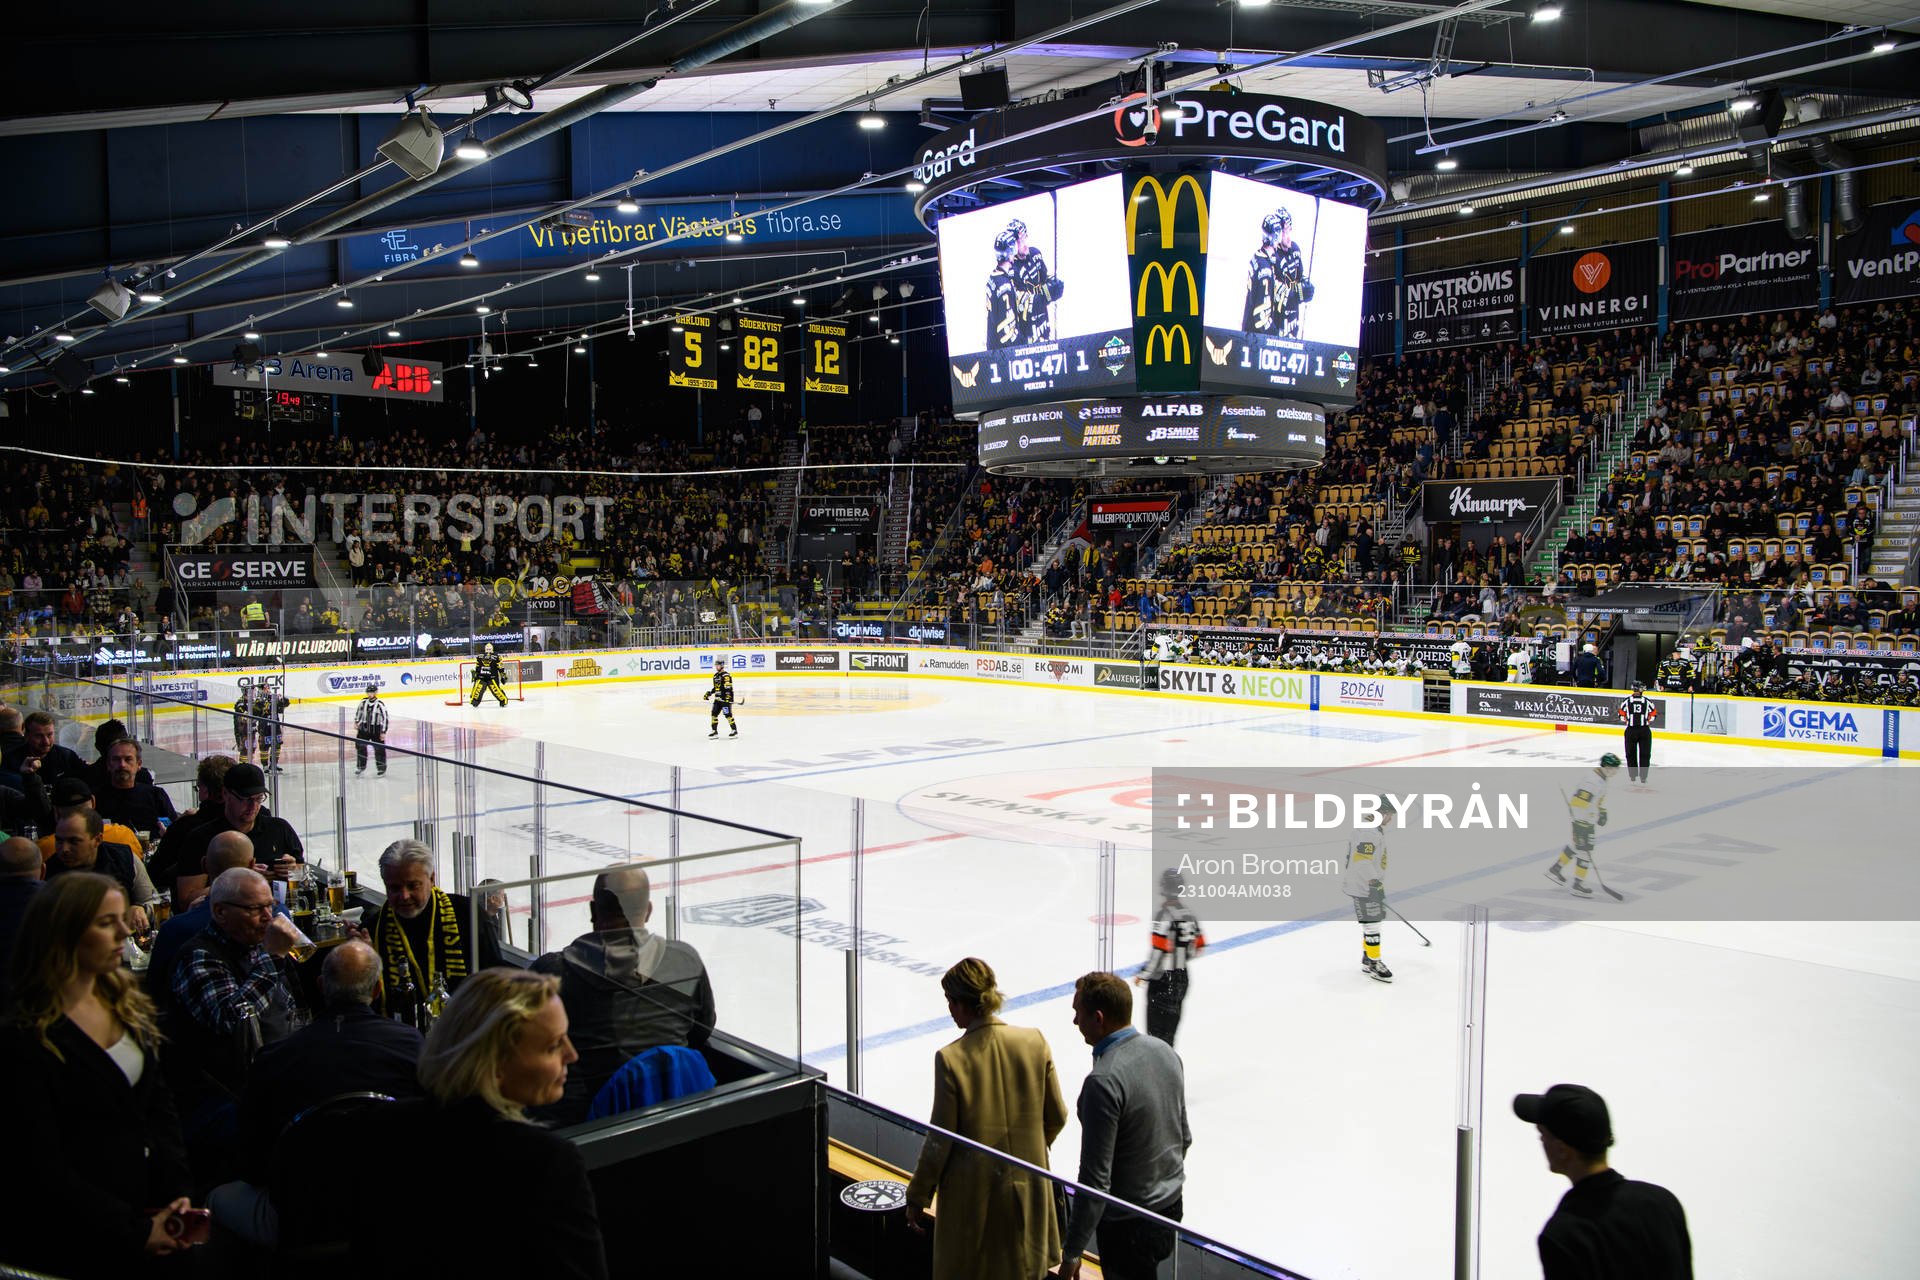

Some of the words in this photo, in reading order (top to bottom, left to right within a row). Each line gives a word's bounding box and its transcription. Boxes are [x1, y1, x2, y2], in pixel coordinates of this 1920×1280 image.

[1175, 100, 1345, 153] PreGard
[766, 211, 842, 233] fibra.se
[384, 254, 417, 263] FIBRA
[1675, 250, 1811, 281] ProjPartner
[1848, 251, 1920, 279] VentP
[1407, 270, 1513, 302] NYSTRÖMS
[1407, 296, 1458, 322] BILAR
[1462, 297, 1489, 309] 021-81
[1491, 295, 1502, 306] 61
[1503, 293, 1514, 304] 00
[1539, 294, 1648, 321] VINNERGI
[739, 317, 782, 333] SÖDERKVIST
[1593, 319, 1618, 328] FUTURE
[1621, 316, 1643, 324] SMART
[807, 323, 846, 337] JOHANSSON
[685, 331, 702, 368] 5
[744, 335, 778, 372] 82
[814, 339, 839, 375] 12
[990, 363, 1001, 384] 1
[1012, 354, 1062, 380] 00:47
[1077, 350, 1089, 371] 1
[1240, 346, 1251, 367] 1
[1262, 349, 1305, 374] 00:47
[1315, 356, 1325, 376] 1
[290, 359, 353, 382] Arena
[372, 363, 432, 393] ABB
[1038, 410, 1063, 421] NEON
[1141, 404, 1203, 417] ALFAB
[1221, 405, 1266, 417] Assemblin
[1085, 424, 1120, 435] DIAMANT
[1167, 426, 1199, 437] SMIDE
[1082, 434, 1121, 446] PARTNERS
[1449, 486, 1537, 518] Kinnarps
[248, 492, 614, 546] INTERSPORT
[809, 507, 870, 517] OPTIMERA
[527, 600, 556, 609] SKYDD
[837, 623, 882, 637] digiwise
[909, 625, 945, 639] digiwise
[236, 643, 248, 657] VI
[248, 640, 265, 656] ÄR
[291, 641, 297, 654] I
[573, 659, 596, 669] EURO
[640, 656, 690, 671] bravida
[780, 656, 804, 664] JUMP
[814, 656, 835, 664] YARD
[871, 654, 906, 669] FRONT
[930, 659, 969, 670] Ramudden
[976, 659, 1021, 673] PSDAB.se
[567, 666, 602, 678] JACKPOT
[1035, 662, 1083, 675] EKONOMI
[1160, 669, 1216, 693] SKYLT
[1222, 673, 1236, 695] &
[1242, 675, 1303, 700] NEON
[1514, 700, 1544, 712] M&M
[1546, 702, 1609, 717] CARAVANE
[1633, 704, 1642, 713] 13
[1789, 709, 1859, 733] GEMA
[1789, 730, 1859, 743] VVS-TEKNIK
[714, 738, 1005, 778] ALFAB
[922, 791, 1108, 826] SVENSKA
[1112, 822, 1229, 846] SPEL
